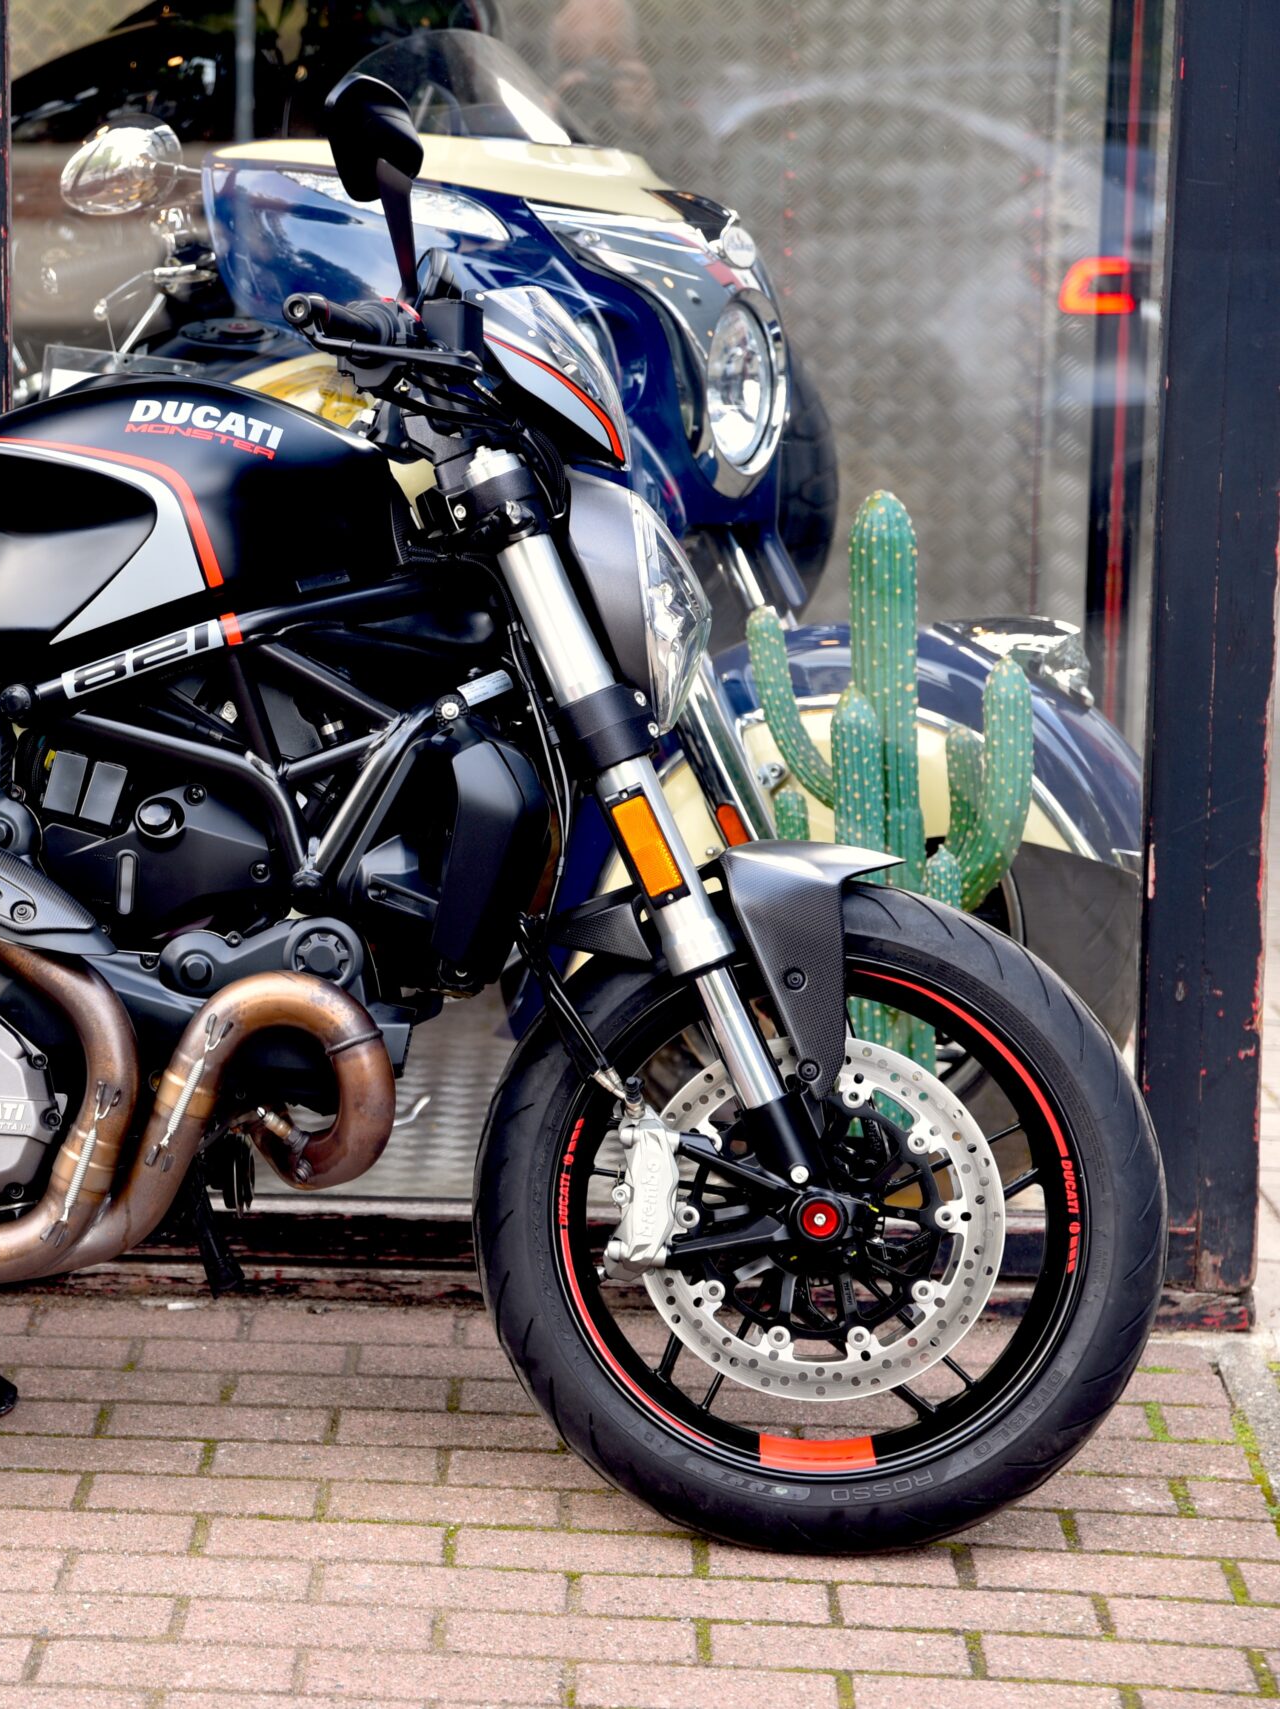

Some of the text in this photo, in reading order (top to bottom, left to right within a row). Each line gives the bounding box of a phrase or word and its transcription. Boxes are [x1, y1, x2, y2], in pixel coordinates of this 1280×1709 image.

[124, 423, 276, 460] MONSTER
[128, 399, 284, 450] DUCATI
[73, 623, 209, 693] 821
[558, 1173, 571, 1226] DUCATI
[1061, 1159, 1080, 1214] DUCATI
[973, 1368, 1066, 1459] DIABLO
[831, 1470, 934, 1501] ROSSO
